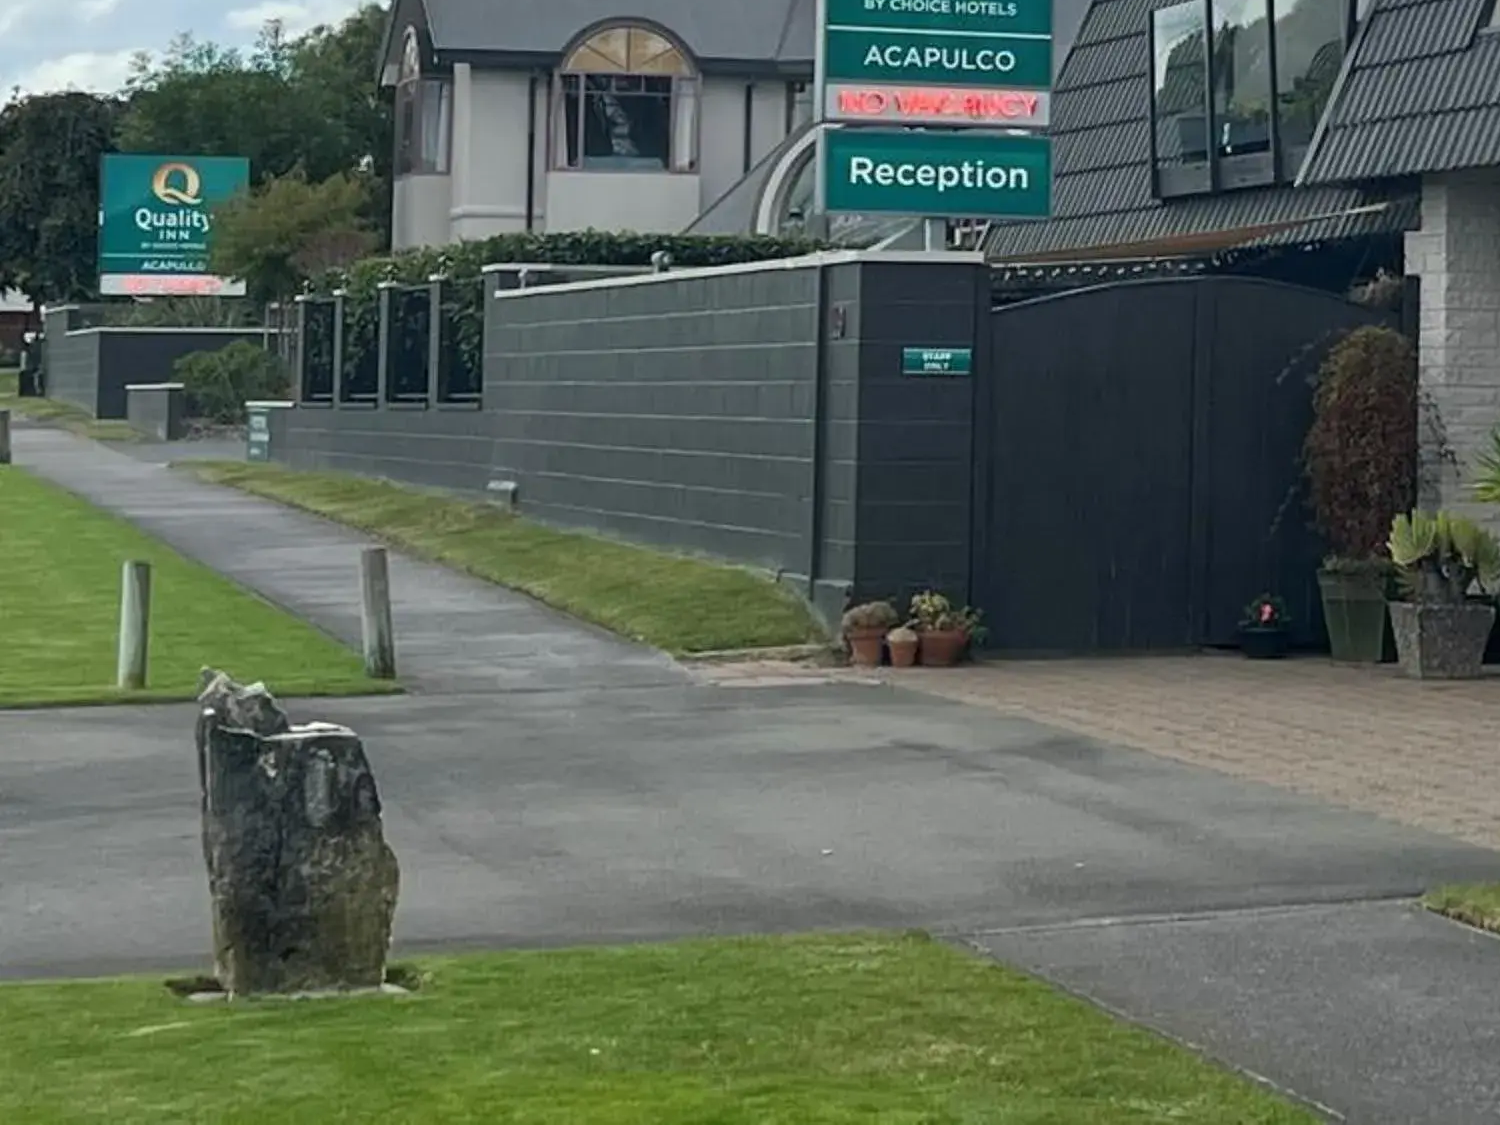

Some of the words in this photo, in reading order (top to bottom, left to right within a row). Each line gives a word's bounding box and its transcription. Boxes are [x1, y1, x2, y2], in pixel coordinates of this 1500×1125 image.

[955, 2, 1018, 18] HOTELS
[864, 46, 1016, 72] ACAPULCO
[838, 90, 888, 114] NO
[894, 90, 1038, 118] VACANCY
[850, 157, 1029, 191] Reception
[135, 208, 215, 233] Quality
[159, 230, 190, 241] INN
